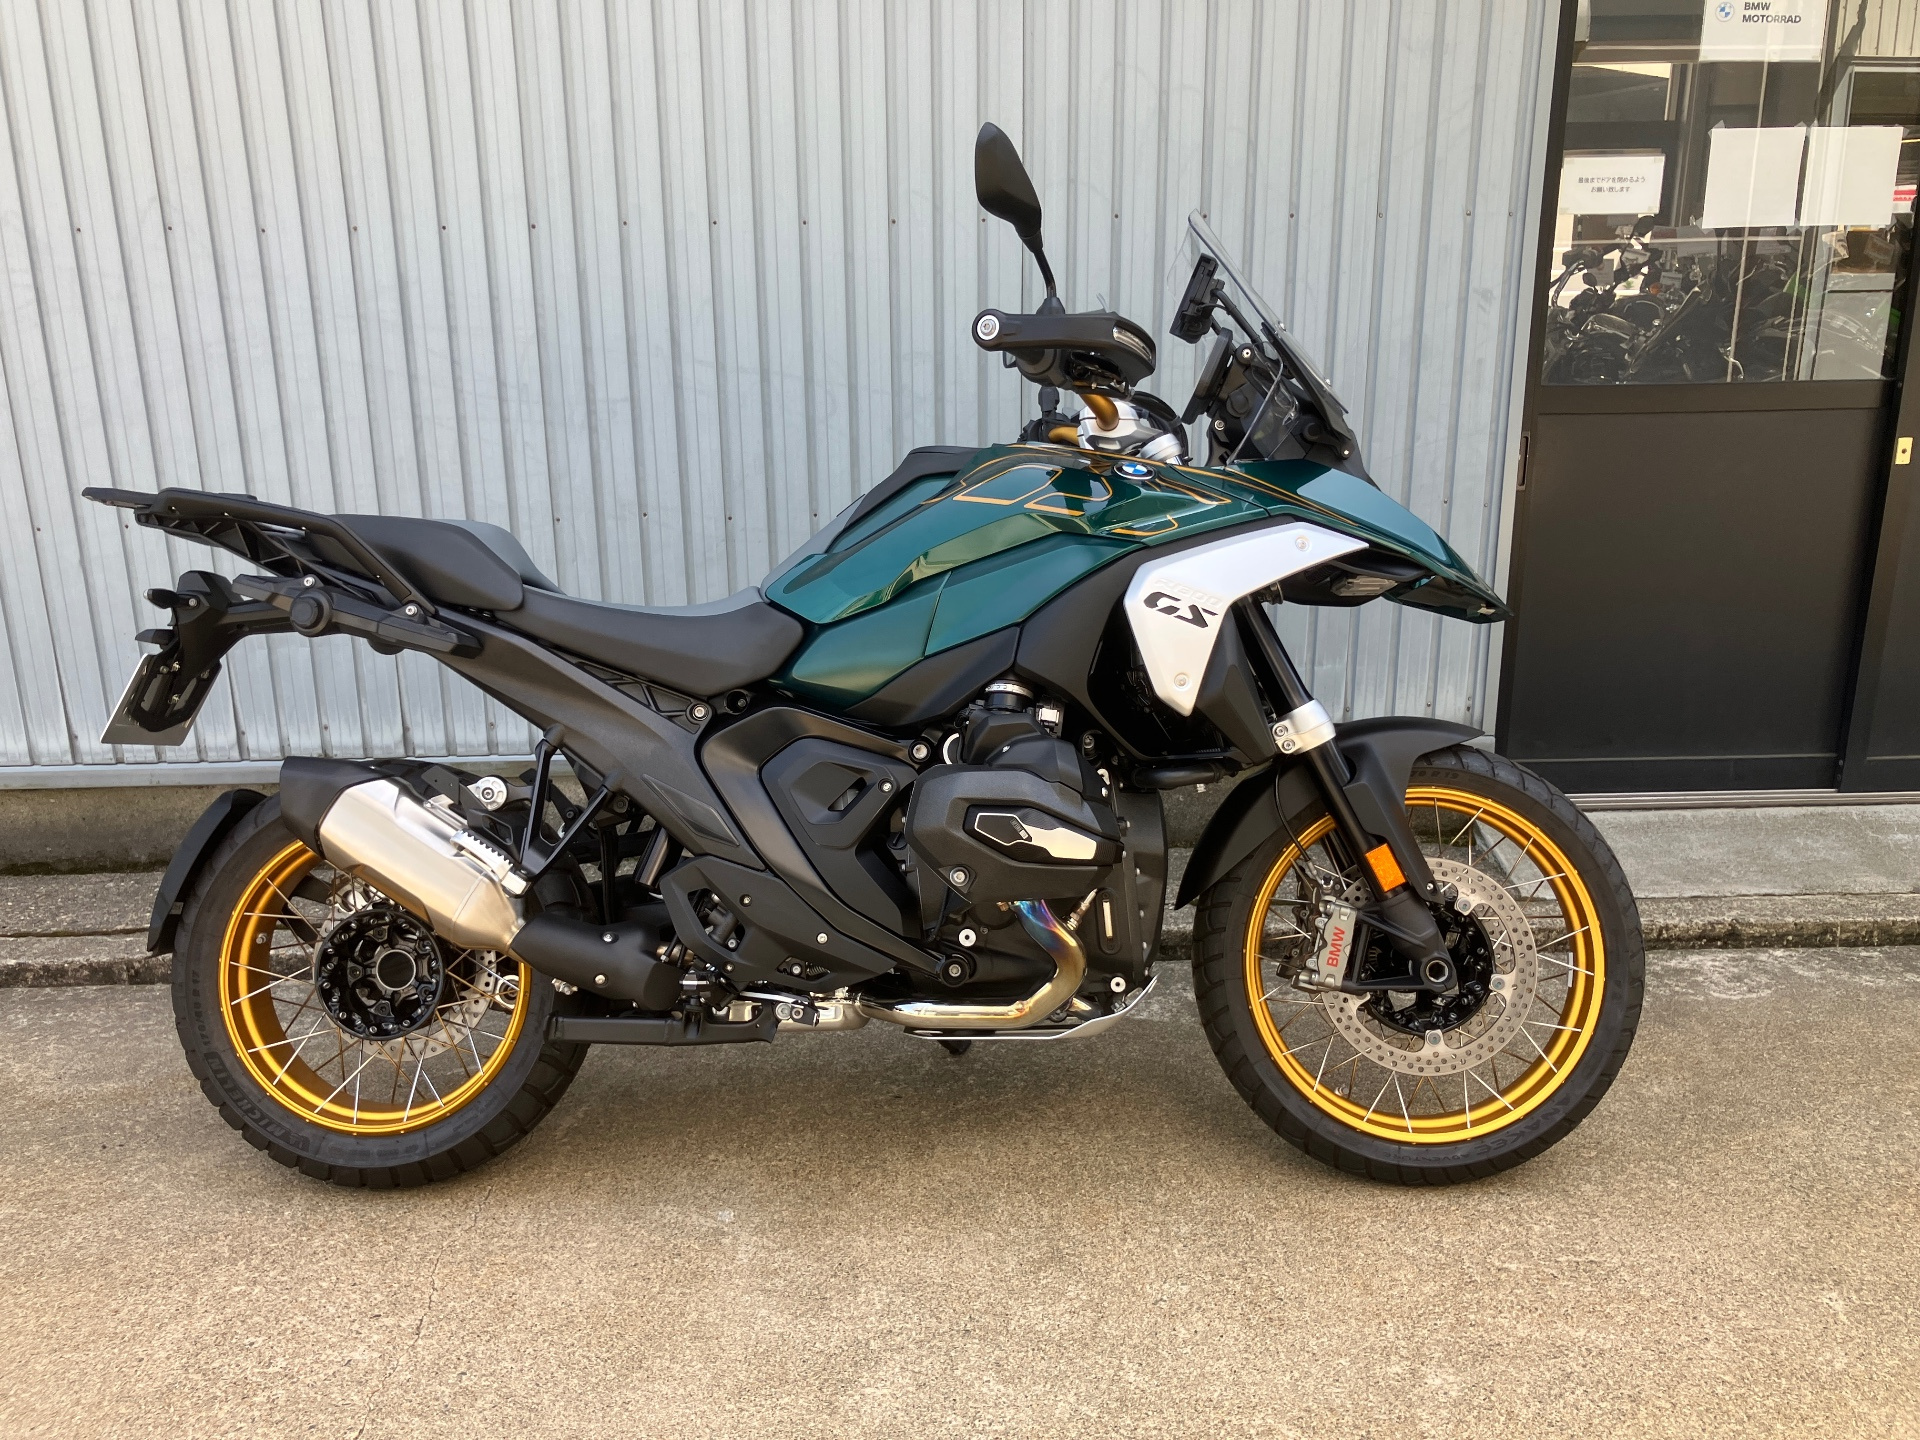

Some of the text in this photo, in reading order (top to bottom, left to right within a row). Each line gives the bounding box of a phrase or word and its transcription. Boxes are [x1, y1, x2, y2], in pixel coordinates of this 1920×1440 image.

[1742, 14, 1802, 23] MOTORRAD
[1743, 2, 1771, 11] BMW
[1143, 591, 1219, 629] GS
[1326, 926, 1345, 968] BMW
[207, 1056, 288, 1140] MICHELIN
[1474, 1094, 1571, 1155] ANAKEE
